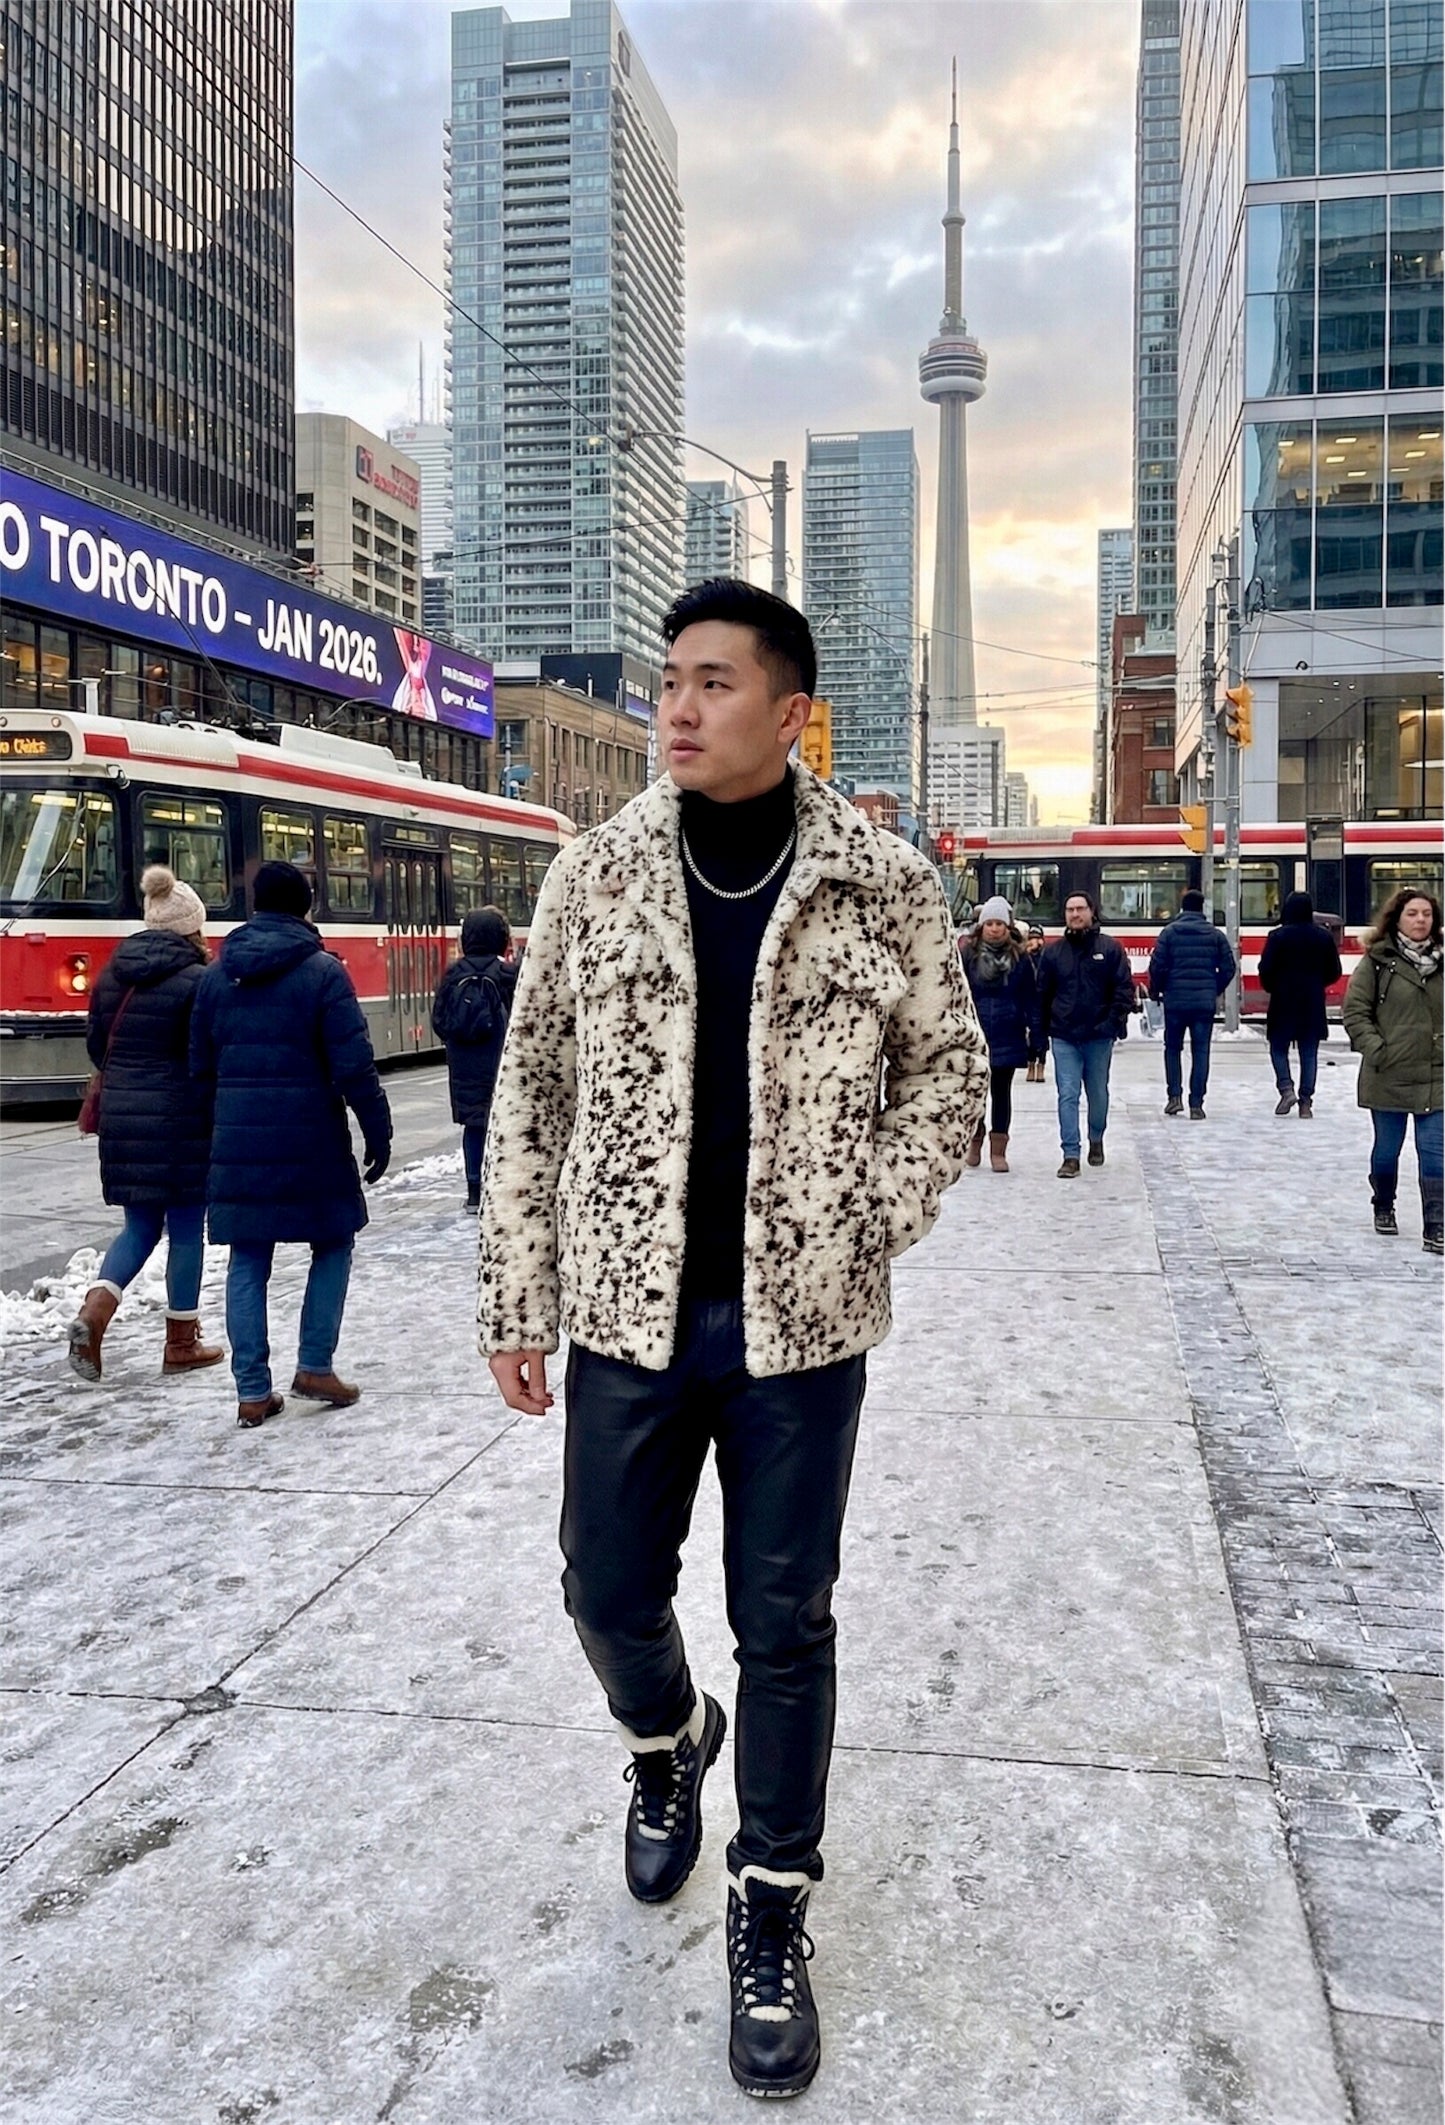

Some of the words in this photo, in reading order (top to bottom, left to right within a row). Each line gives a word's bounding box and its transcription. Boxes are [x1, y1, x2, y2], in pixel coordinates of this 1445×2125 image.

[0, 501, 30, 570] O
[40, 515, 227, 633] TORONTO
[257, 599, 312, 662] JAN
[319, 618, 382, 685] 2026.
